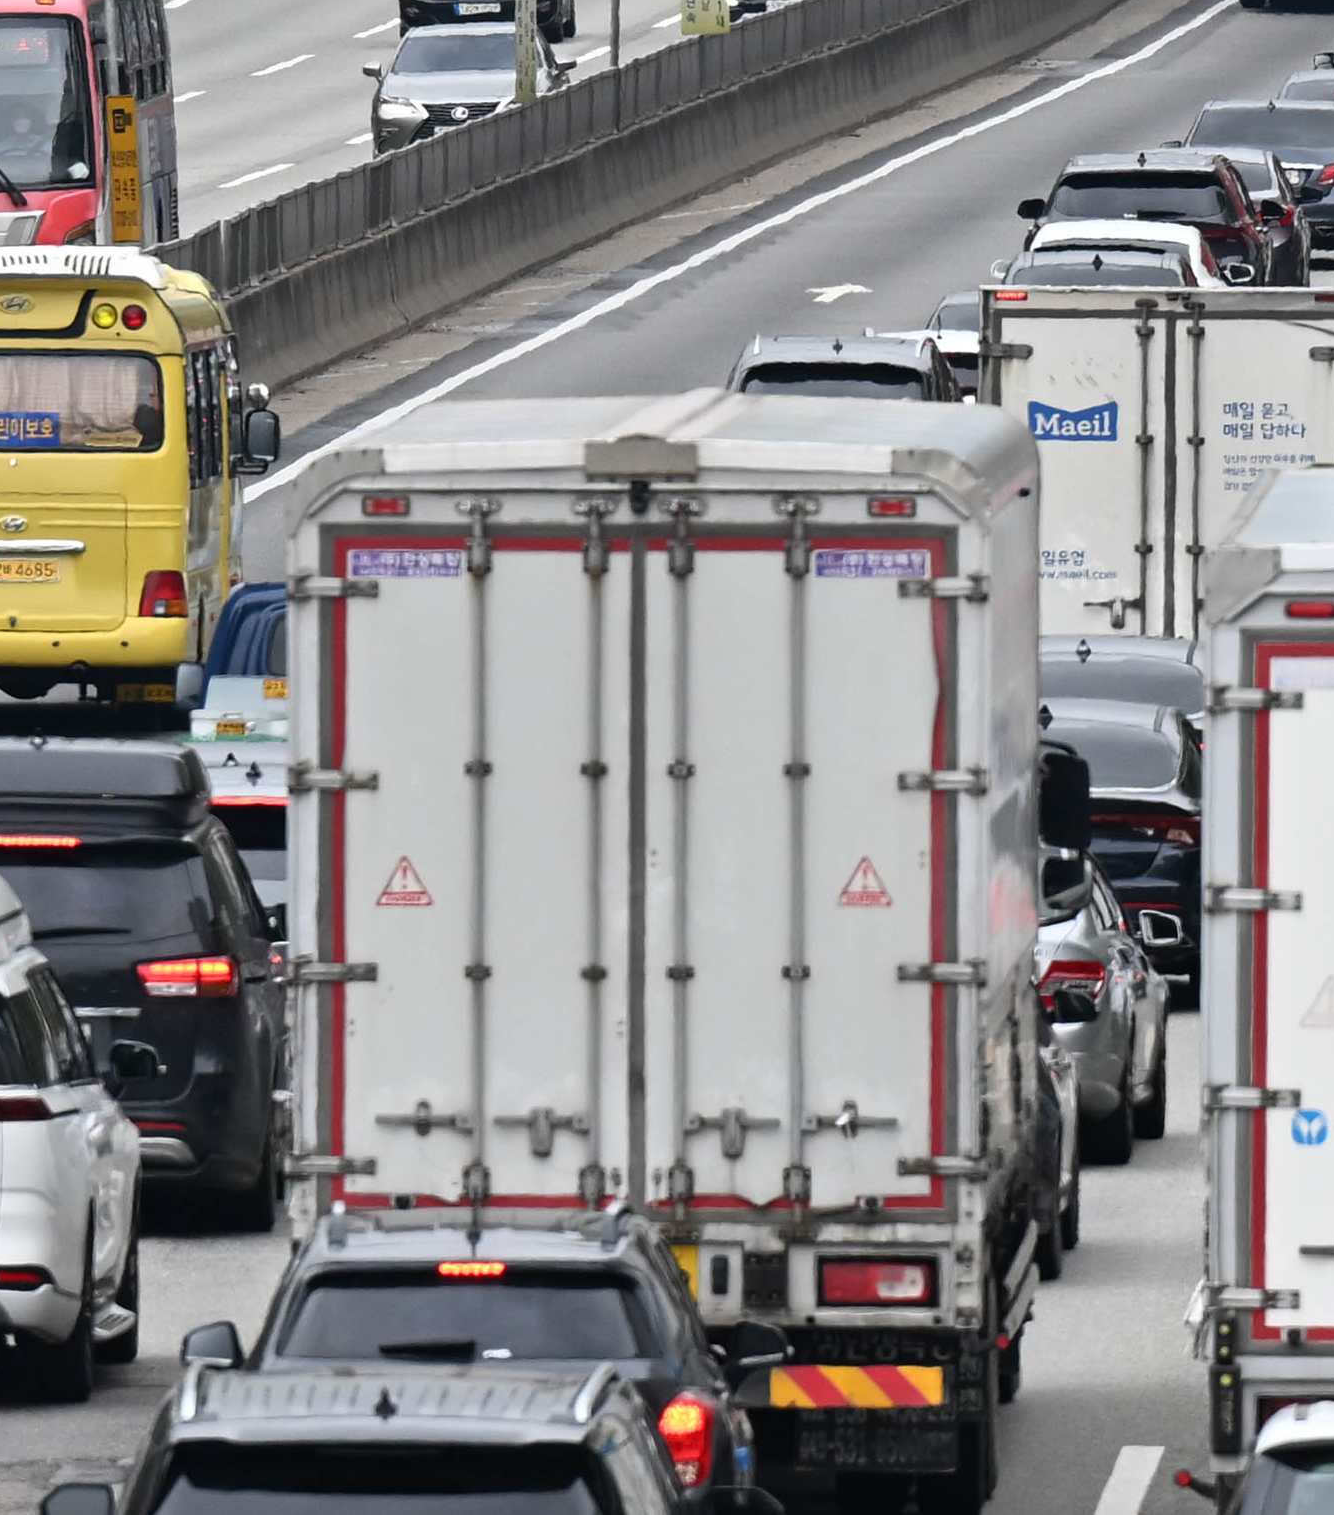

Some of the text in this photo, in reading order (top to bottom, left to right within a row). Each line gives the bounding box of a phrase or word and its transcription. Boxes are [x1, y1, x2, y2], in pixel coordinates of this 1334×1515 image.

[1223, 402, 1254, 420] 매일
[1034, 411, 1112, 436] Maeil
[1223, 423, 1254, 440] 매일
[15, 563, 54, 577] 4685
